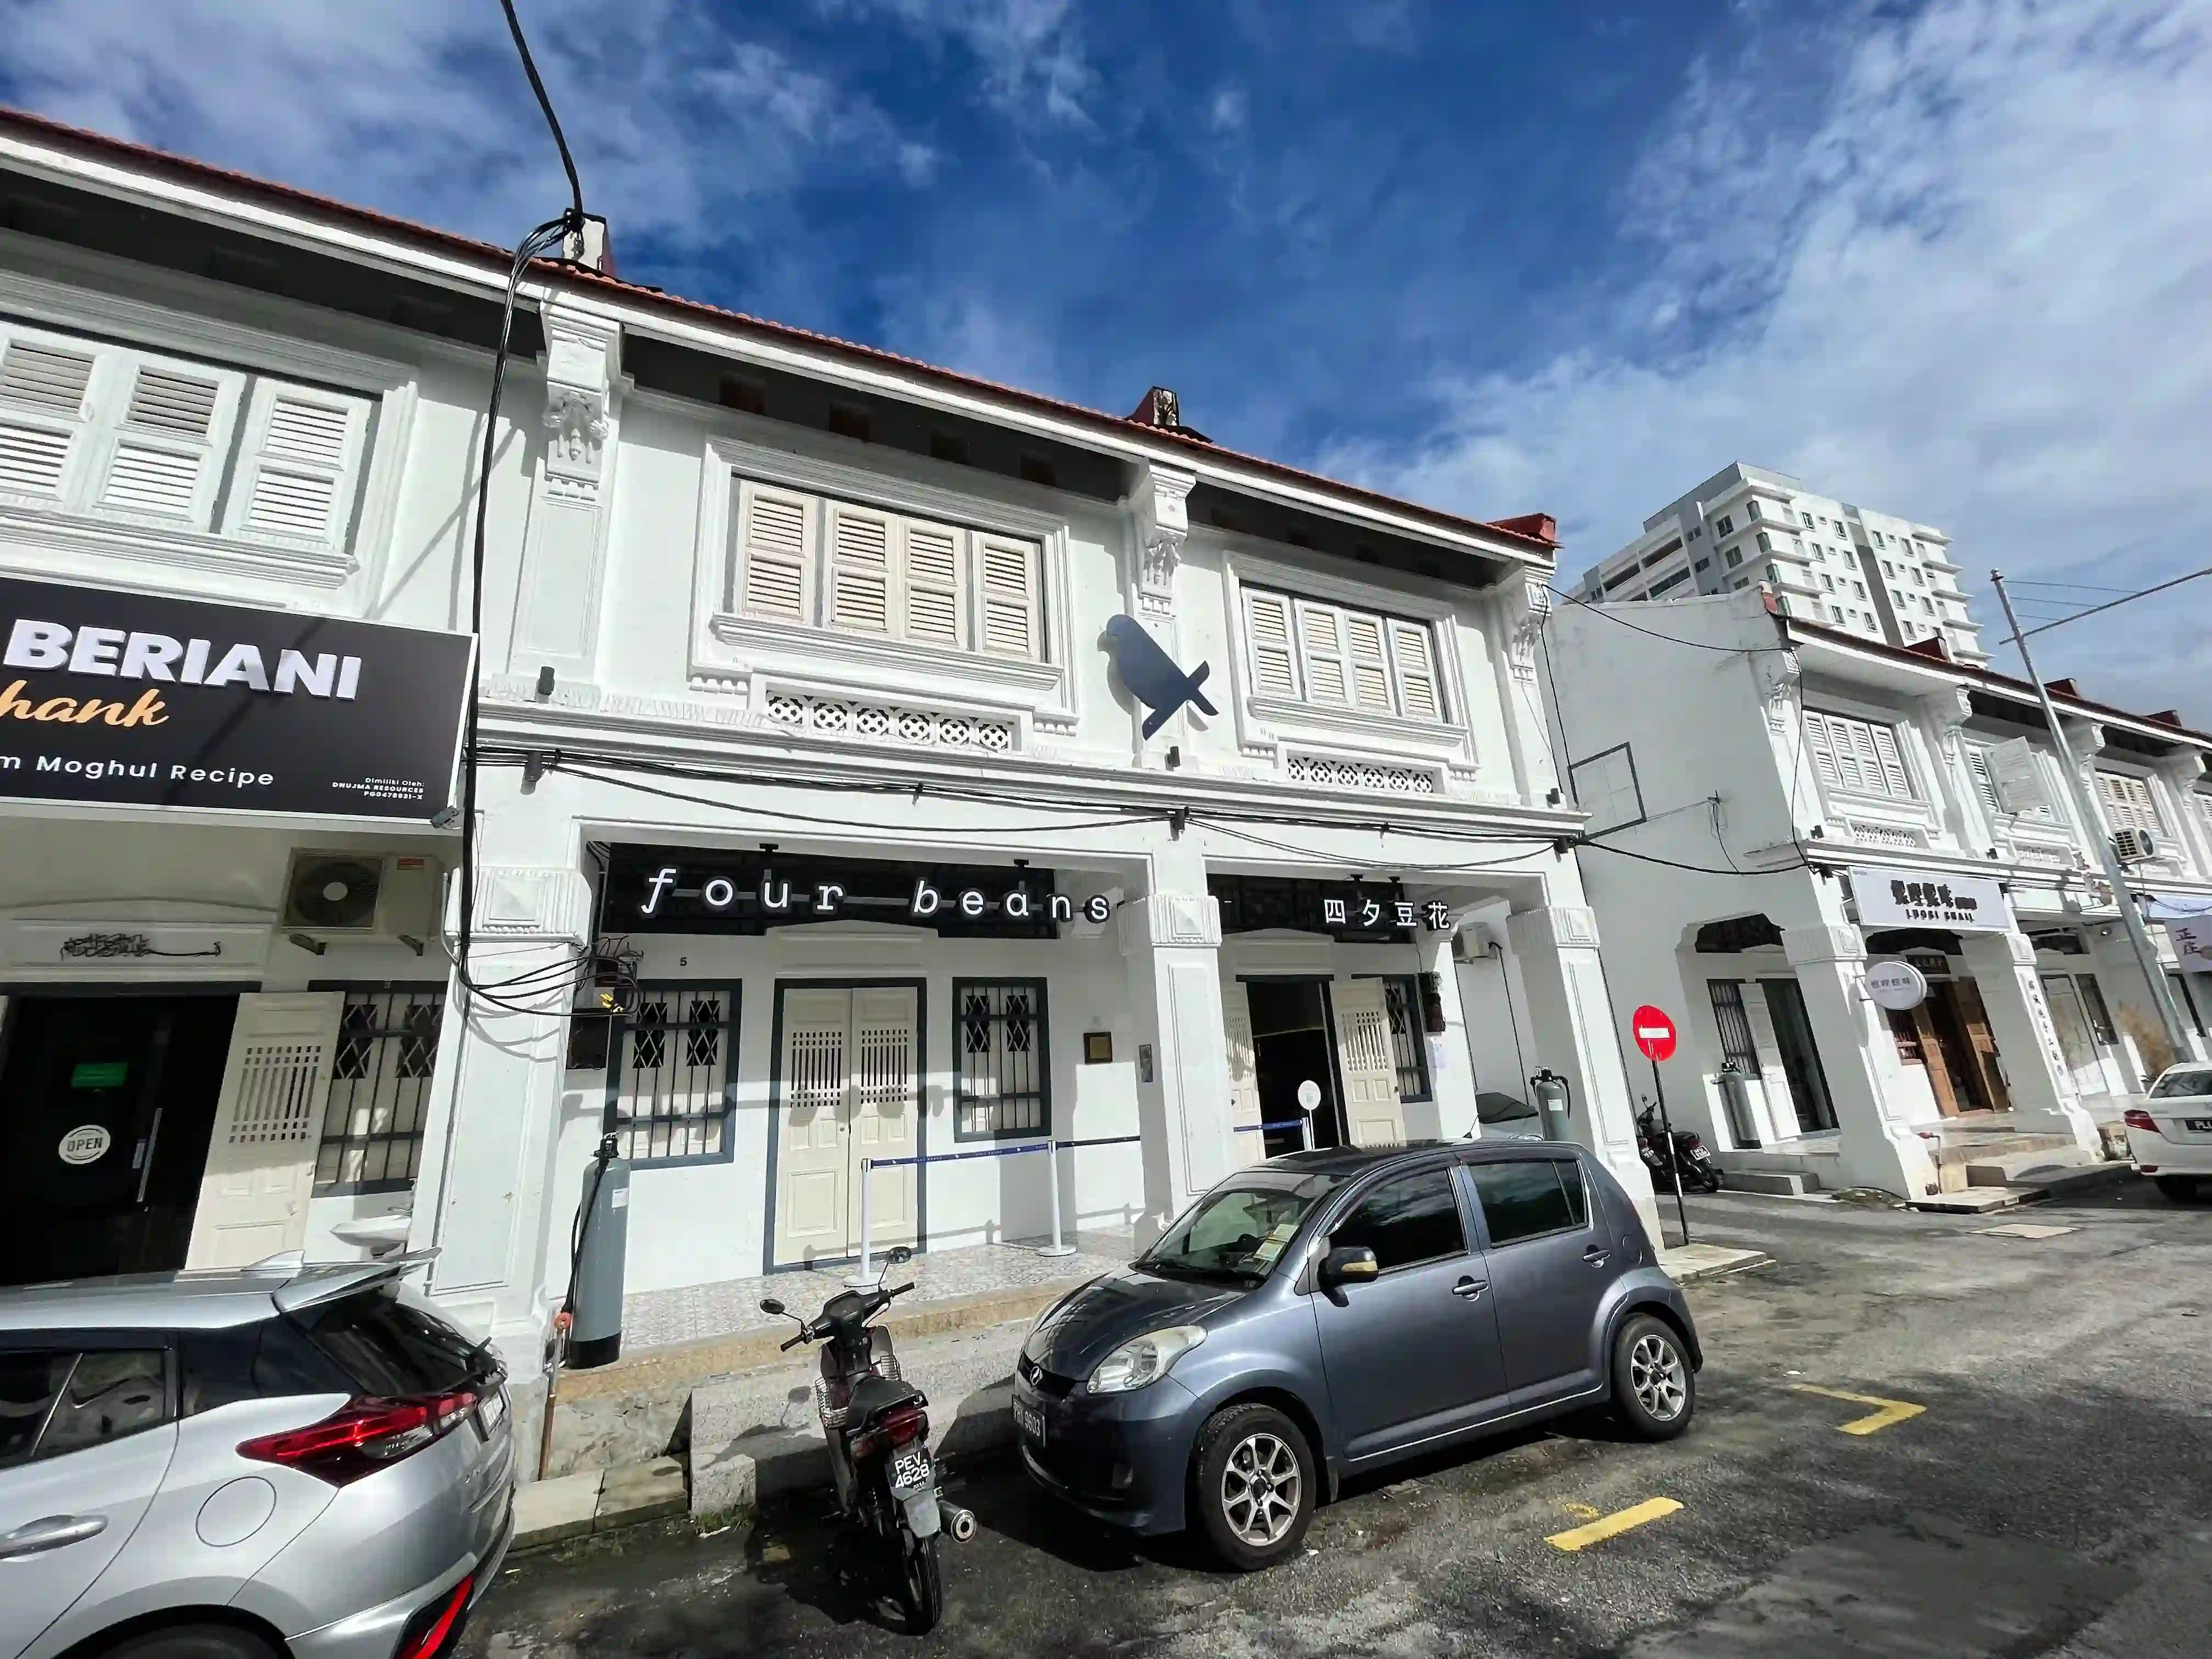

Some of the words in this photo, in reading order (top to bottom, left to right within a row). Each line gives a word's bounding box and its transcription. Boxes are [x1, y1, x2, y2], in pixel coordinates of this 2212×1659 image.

[3, 618, 362, 700] BERIANI
[36, 755, 157, 779] Moghul
[170, 765, 274, 788] Recipe
[641, 868, 844, 913] four
[914, 880, 1108, 920] beans
[1324, 899, 1450, 929] 四夕豆花
[680, 957, 687, 966] 5
[66, 1137, 103, 1152] OPEN
[894, 1451, 921, 1475] PEV
[895, 1463, 930, 1488] 4628
